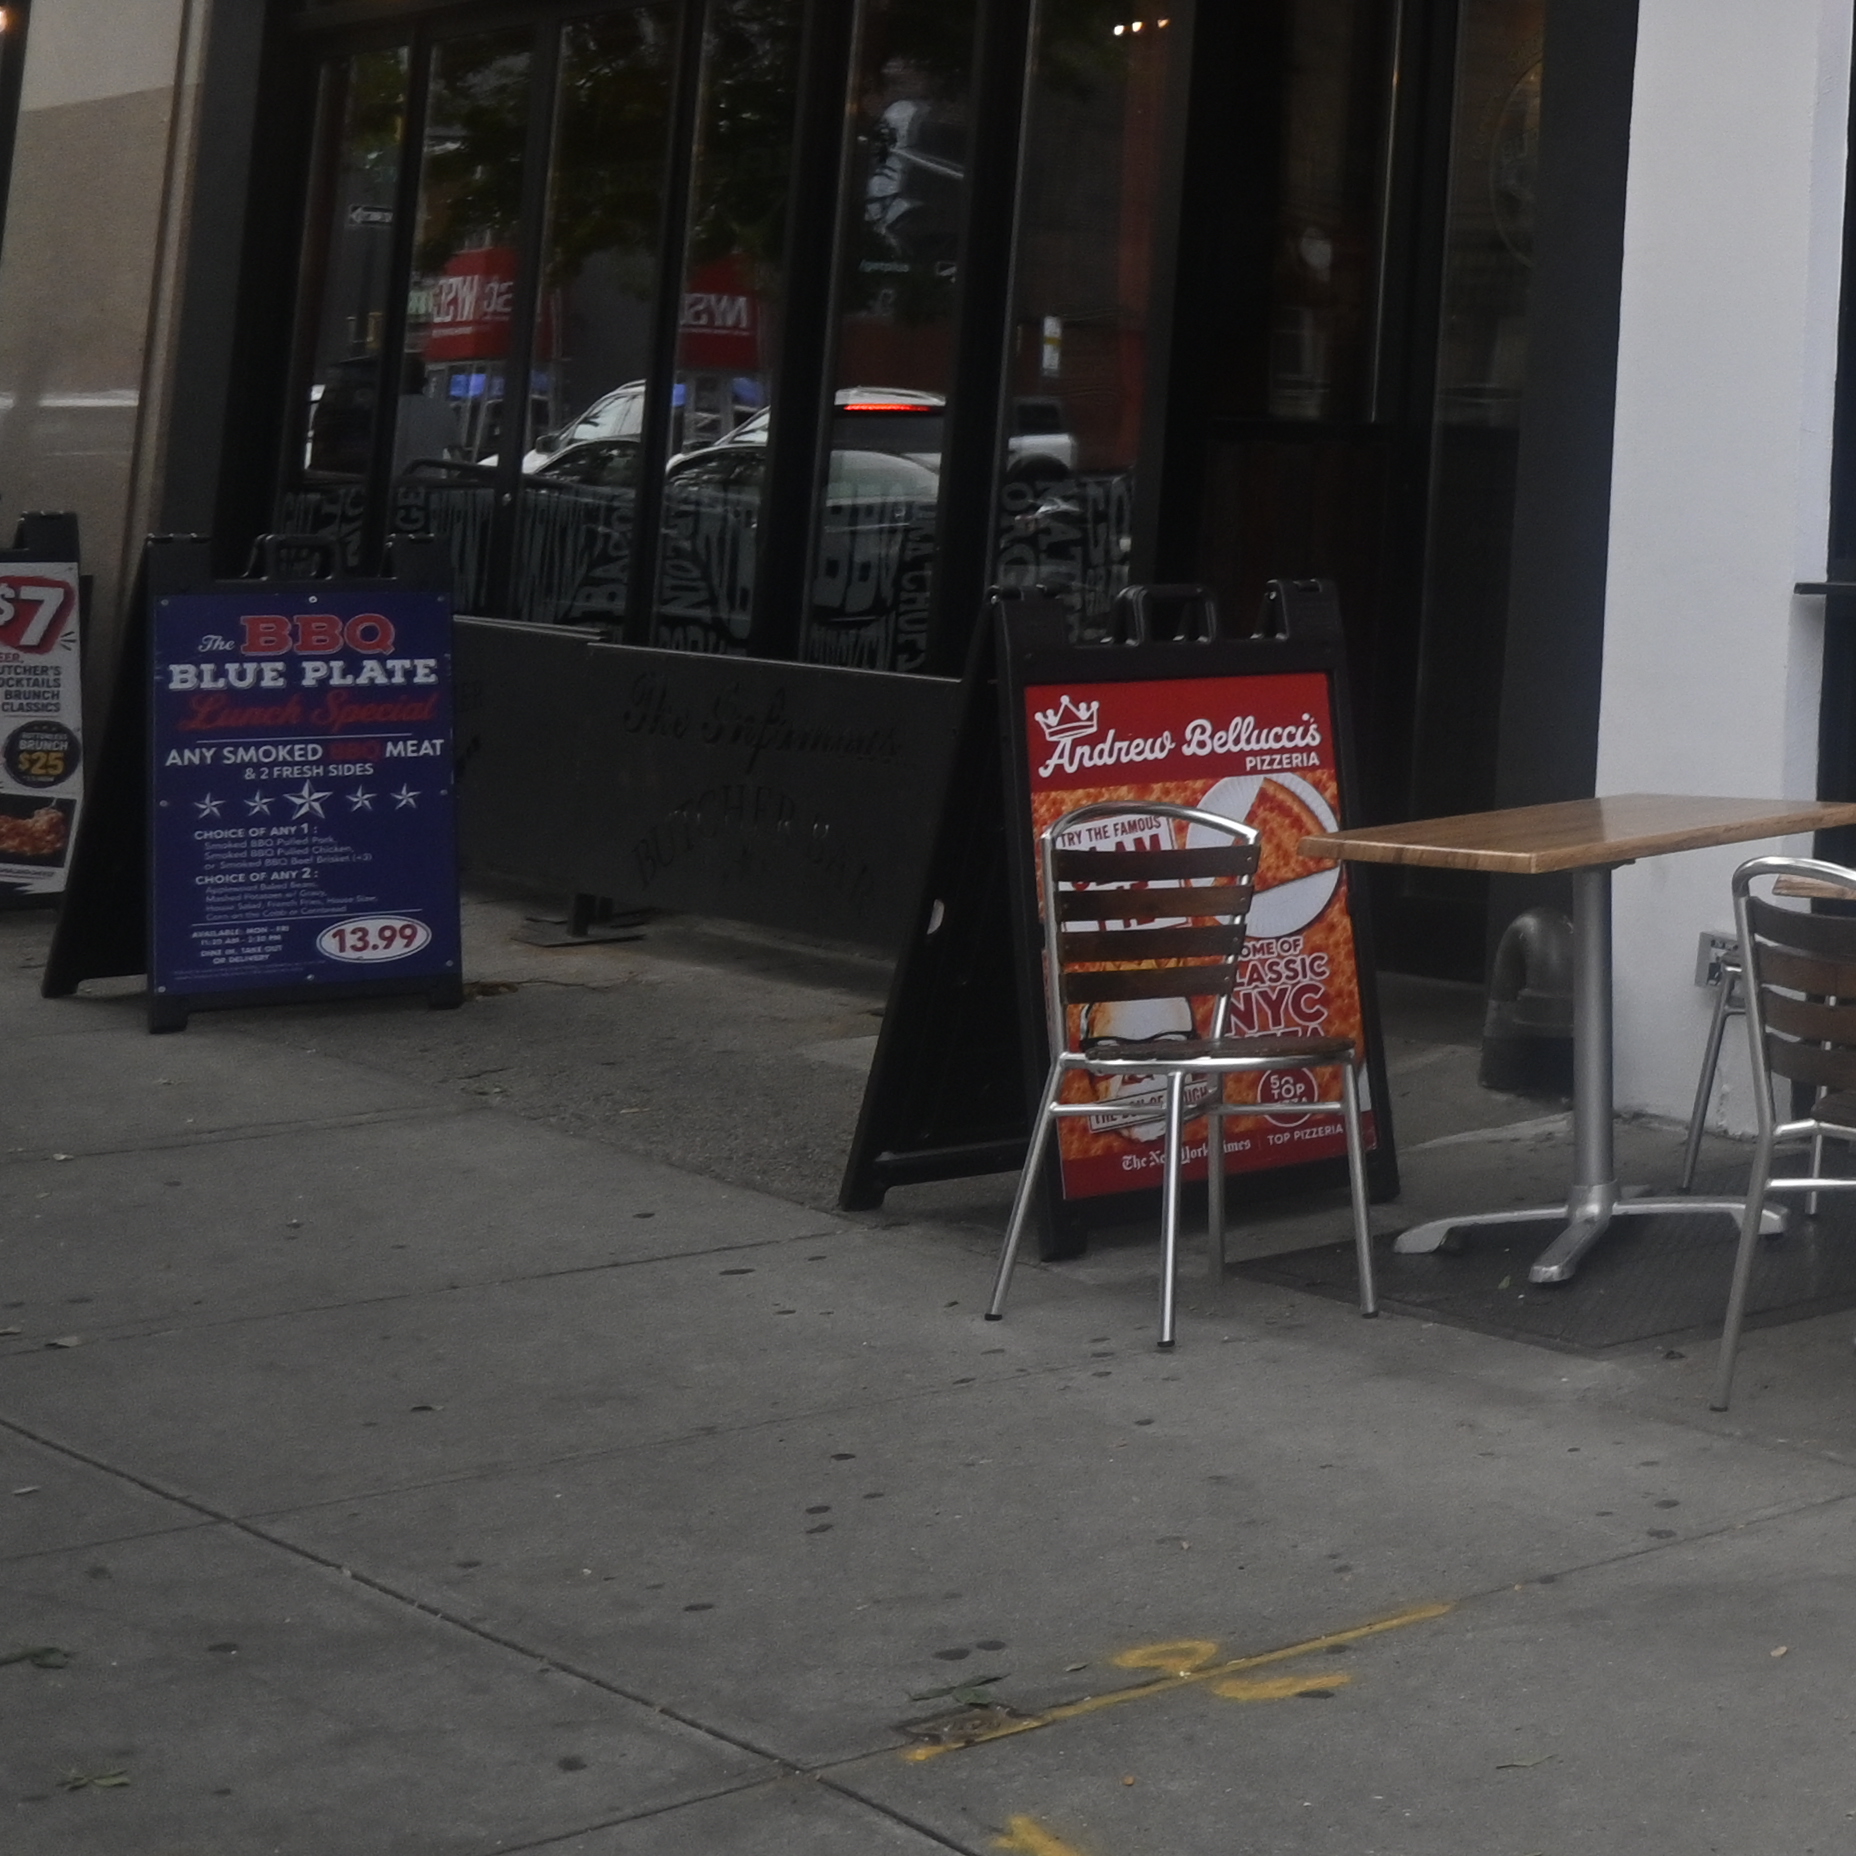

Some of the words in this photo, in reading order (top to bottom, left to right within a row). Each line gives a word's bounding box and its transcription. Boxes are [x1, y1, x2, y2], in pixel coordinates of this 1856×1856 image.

[198, 634, 235, 653] The
[239, 613, 396, 656] BBQ
[0, 665, 62, 676] UTCHER'S
[168, 661, 287, 691] BLUE
[301, 658, 439, 687] PLATE
[0, 677, 61, 688] OCKTAILS
[4, 690, 60, 700] BRUNCH
[1, 702, 60, 712] CLASSICS
[176, 692, 303, 732] Lunch
[311, 687, 439, 734] Special
[19, 740, 68, 751] BRUNCH
[165, 747, 217, 767] ANY
[222, 744, 323, 764] SMOKED
[385, 739, 445, 758] MEAT
[1038, 729, 1176, 778] Andrew
[1182, 712, 1322, 757] Bellucci's
[18, 750, 65, 775] $25
[244, 768, 257, 780] &
[260, 767, 269, 779] 2
[273, 765, 324, 779] FRESH
[328, 764, 374, 776] SIDES
[1245, 752, 1321, 771] PIZZERIA
[194, 828, 245, 840] CHOICE
[249, 827, 267, 837] OF
[270, 826, 297, 836] ANY
[1060, 826, 1082, 848] TRY
[1086, 823, 1110, 842] THE
[1113, 815, 1162, 837] FAMOUS
[195, 873, 245, 885] CHOICE
[249, 872, 267, 882] OF
[270, 870, 299, 881] ANY
[331, 923, 419, 953] 13.99
[1239, 940, 1275, 959] OME
[1279, 937, 1303, 955] OF
[1236, 953, 1329, 987] LASSIC
[1230, 983, 1328, 1034] NYC
[1271, 1084, 1305, 1098] TOP
[1267, 1132, 1290, 1146] TOP
[1293, 1124, 1344, 1141] PIZZERIA
[1122, 1154, 1147, 1171] The
[1223, 1139, 1251, 1154] imes
